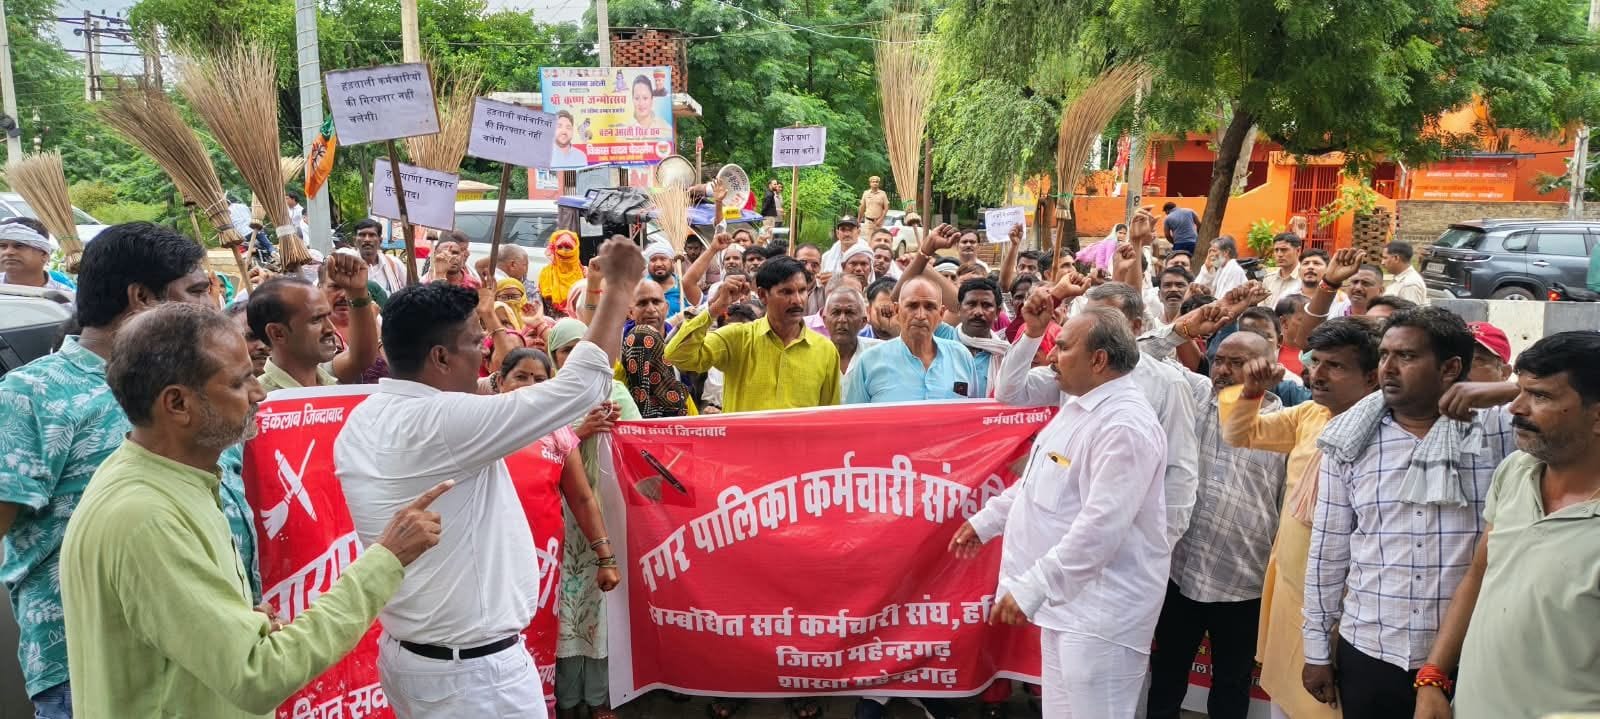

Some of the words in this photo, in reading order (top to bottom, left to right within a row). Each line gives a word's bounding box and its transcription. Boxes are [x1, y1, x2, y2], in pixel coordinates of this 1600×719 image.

[344, 96, 357, 107] की
[398, 89, 414, 100] नहीं
[551, 94, 560, 105] श्री
[425, 177, 454, 189] सरकार
[983, 411, 1024, 425] कर्मचारी
[675, 424, 727, 437] जिन्दाबाद
[690, 485, 797, 553] पालिका
[801, 451, 917, 518] कर्मचारी
[749, 607, 793, 636] सर्व
[798, 604, 901, 637] कर्मचारी
[776, 646, 845, 668] जिला
